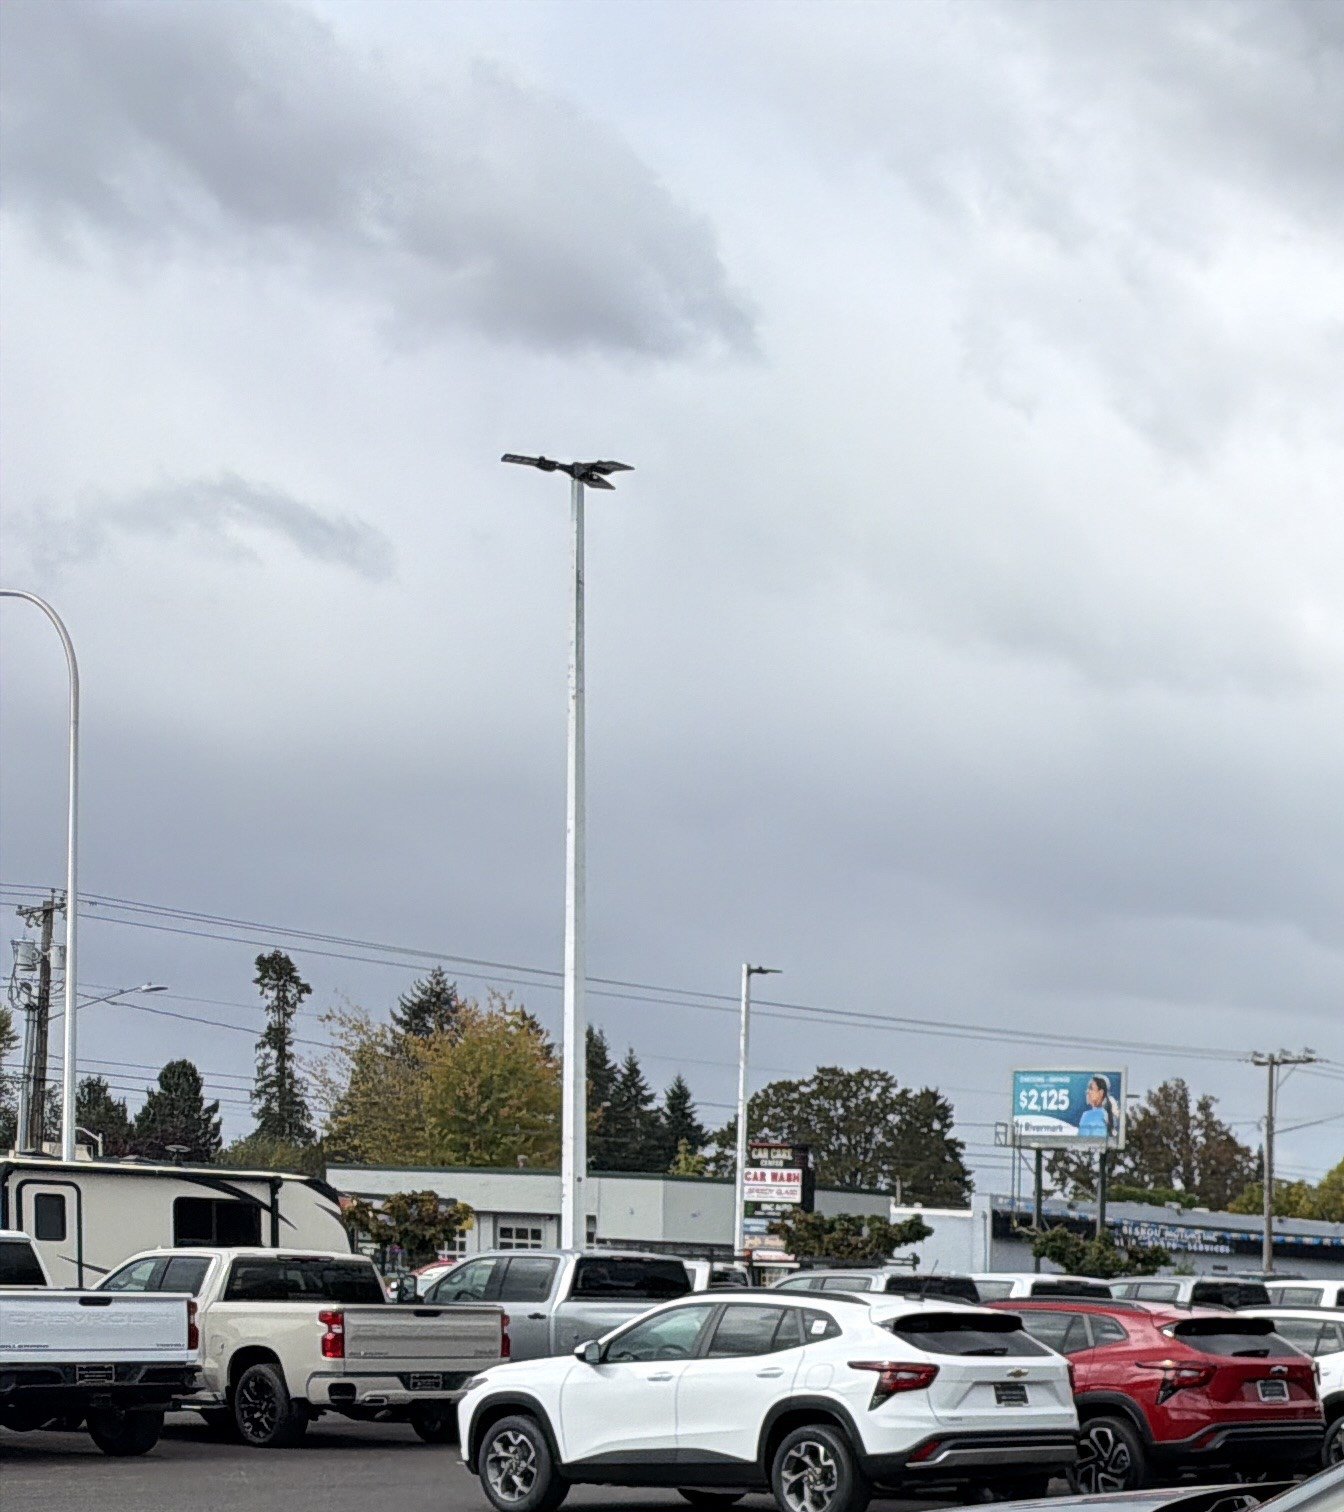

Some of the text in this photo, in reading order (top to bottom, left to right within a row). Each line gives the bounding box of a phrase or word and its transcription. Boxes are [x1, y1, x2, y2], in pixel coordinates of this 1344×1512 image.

[1019, 1088, 1070, 1111] $2,125
[744, 1171, 800, 1182] CAR WASH
